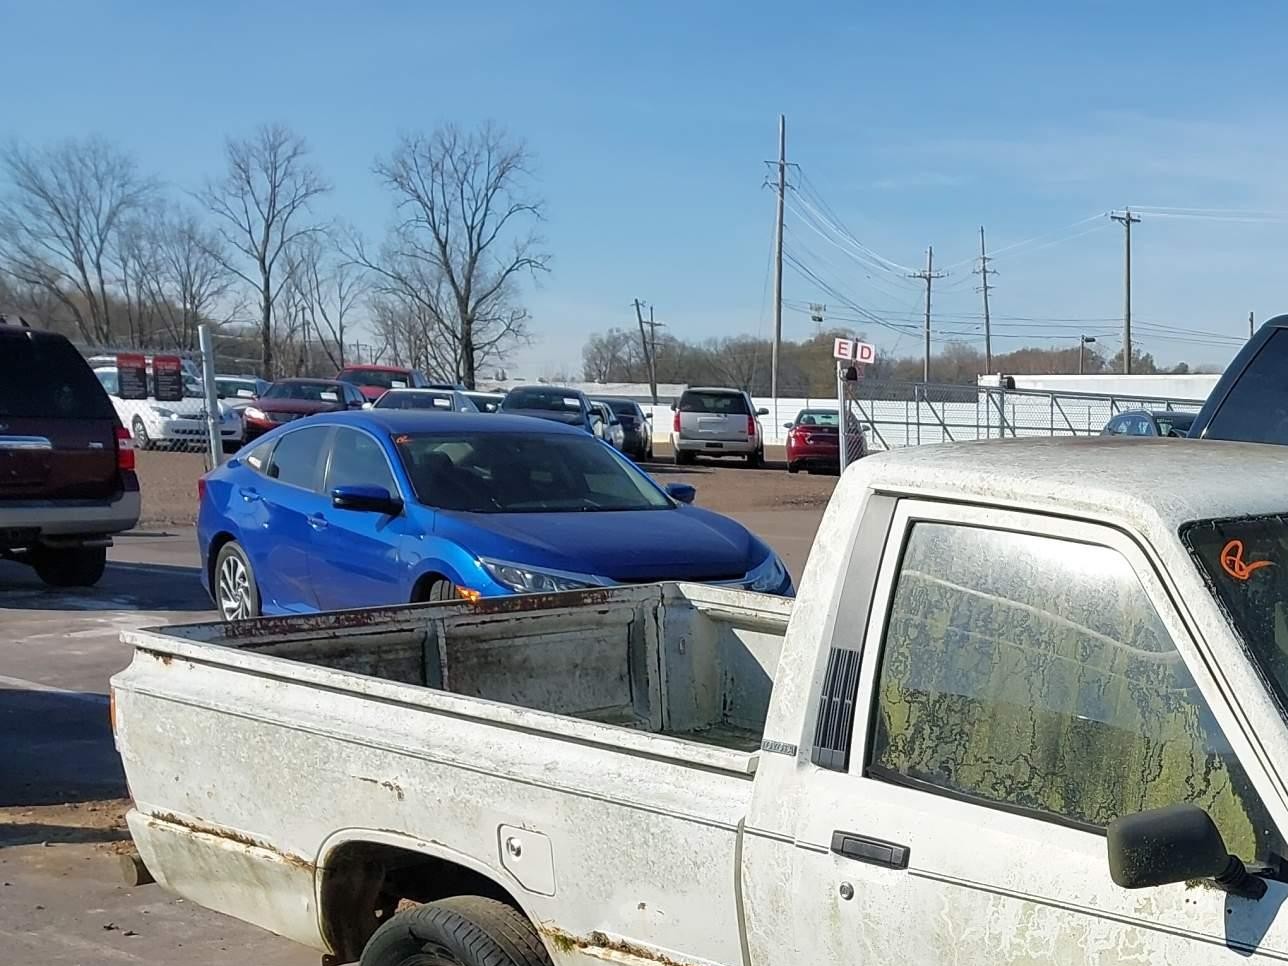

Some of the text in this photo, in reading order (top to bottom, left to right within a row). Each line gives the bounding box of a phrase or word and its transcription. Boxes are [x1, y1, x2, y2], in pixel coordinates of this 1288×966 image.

[838, 341, 849, 356] E
[860, 345, 872, 360] D
[762, 739, 796, 756] TOYOTA
